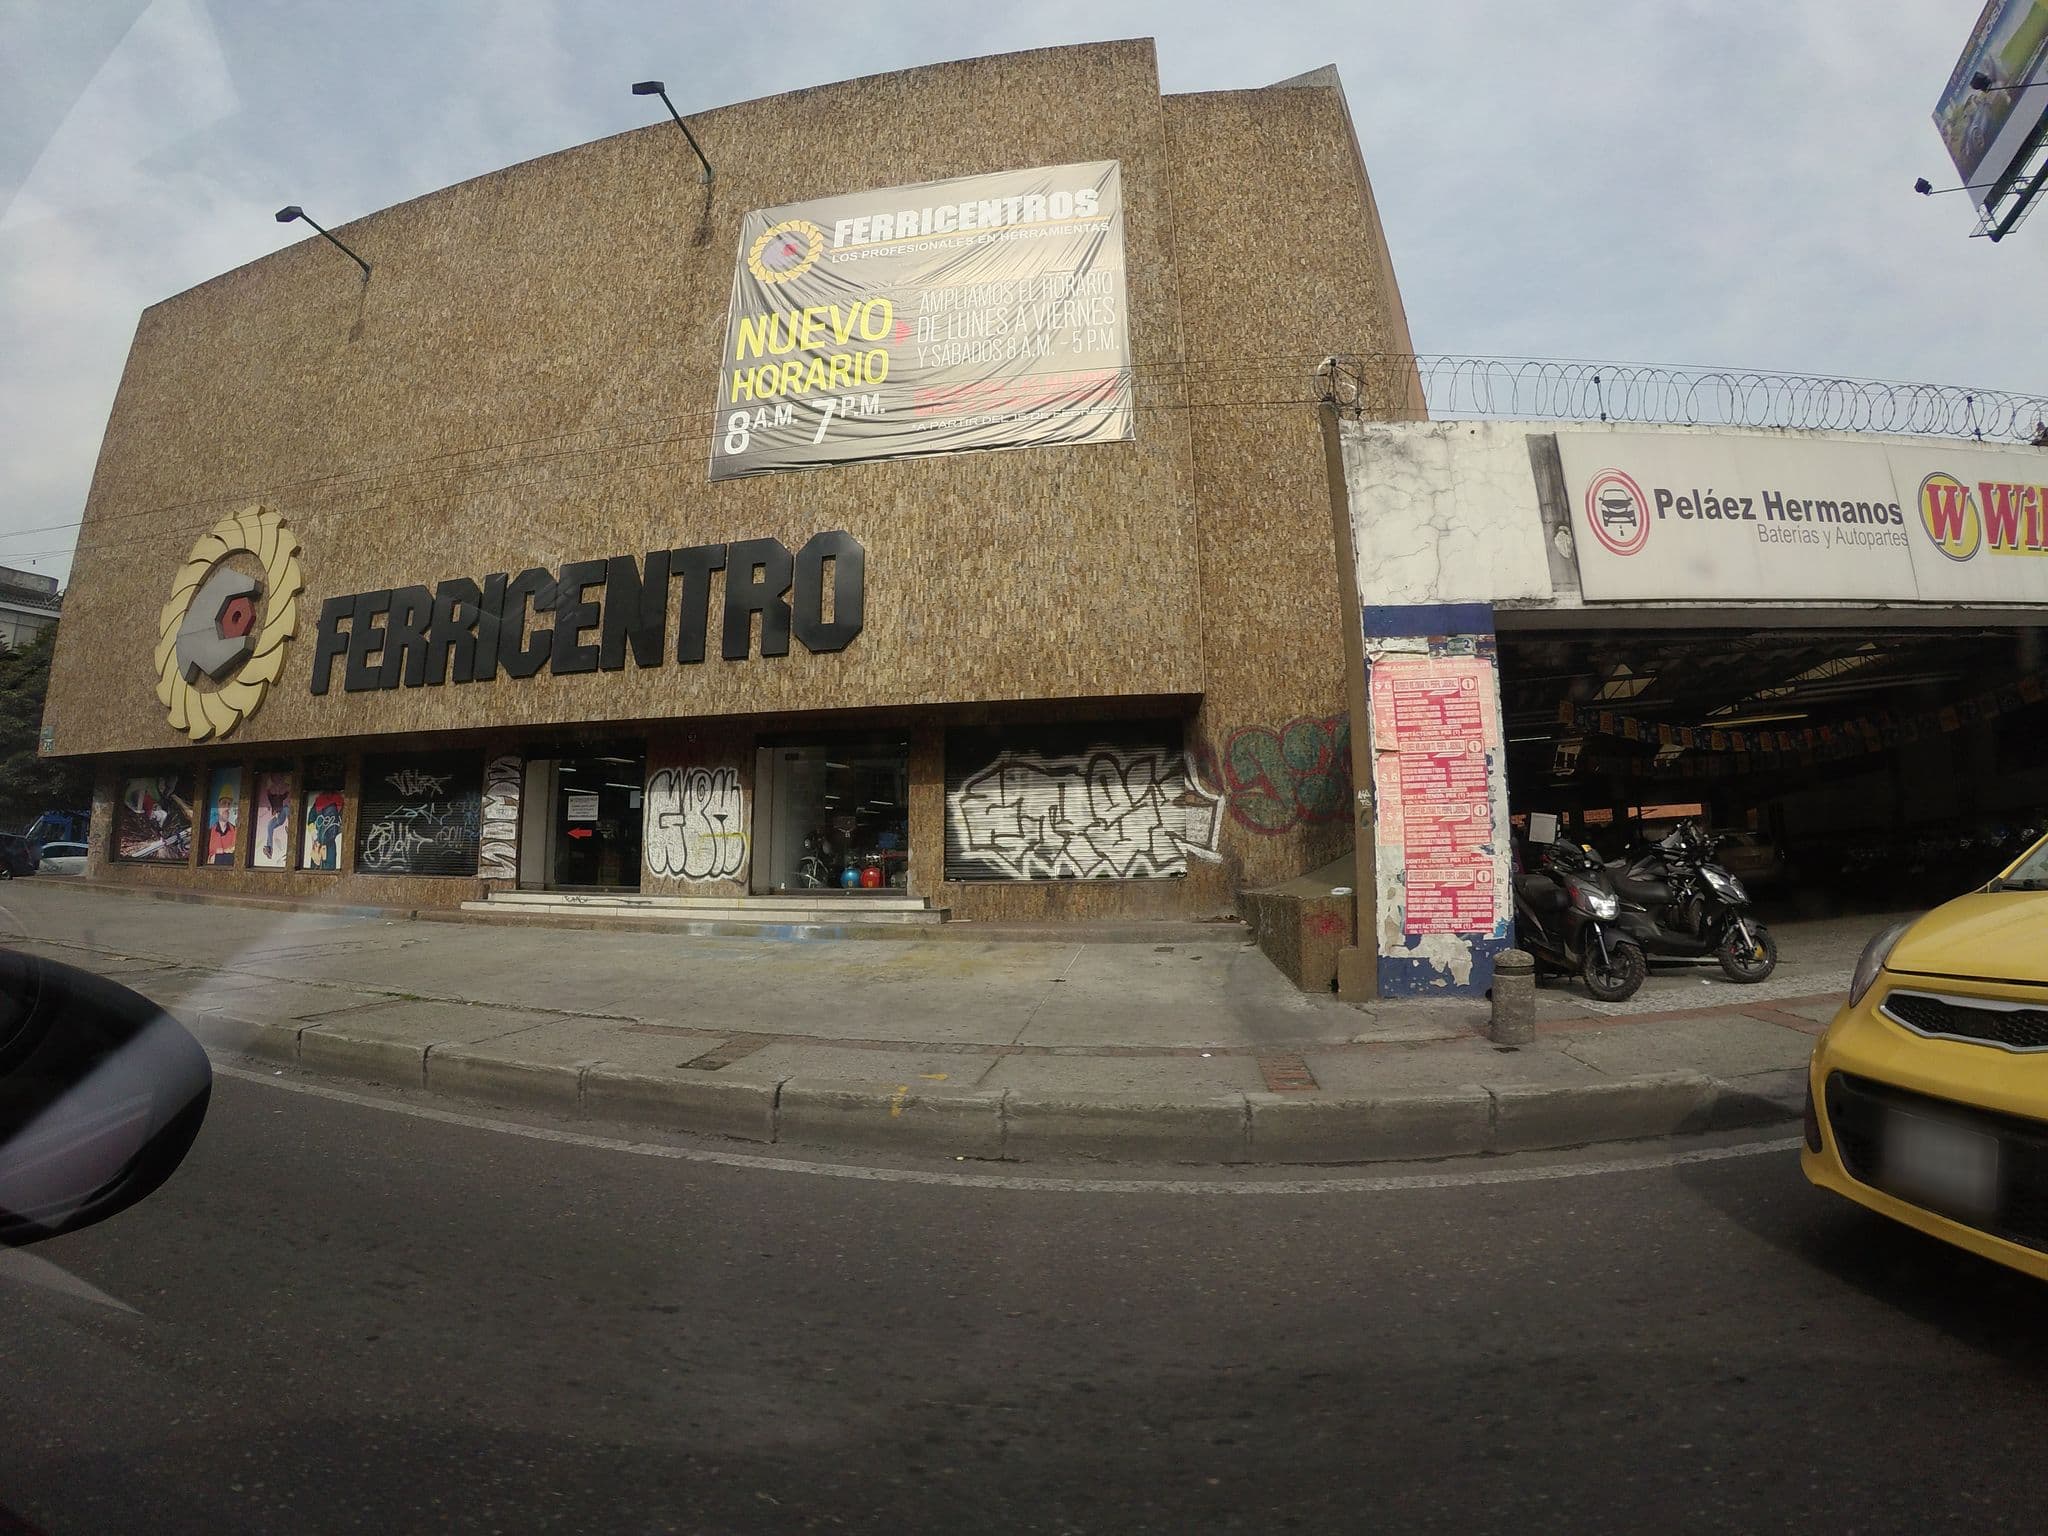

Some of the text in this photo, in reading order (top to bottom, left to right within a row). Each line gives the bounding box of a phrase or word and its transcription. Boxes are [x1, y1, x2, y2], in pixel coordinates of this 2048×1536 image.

[833, 188, 1100, 248] FERRICENTROS
[832, 222, 1110, 263] LOS PROFESIONALES EN HERRAMIENTAS
[920, 272, 1113, 314] AMPLIAMOS EL HORARIO
[736, 299, 893, 361] NUEVO
[917, 297, 1115, 343] DE LUNES A VIERNES
[917, 347, 928, 368] Y
[931, 339, 1002, 367] SÁBADOS
[1007, 338, 1016, 360] 8
[1072, 330, 1082, 353] 5
[1087, 328, 1119, 351] P.M.
[731, 349, 889, 403] HORARIO
[724, 393, 886, 455] 8 A.M. 7 P.M.
[930, 417, 978, 429] PARTIR
[982, 414, 1005, 424] DEL
[1654, 488, 1903, 525] Peláez Hermanos
[1825, 530, 1833, 548] y
[1836, 526, 1909, 549] Autopartes
[310, 529, 865, 696] FERRICENTRO
